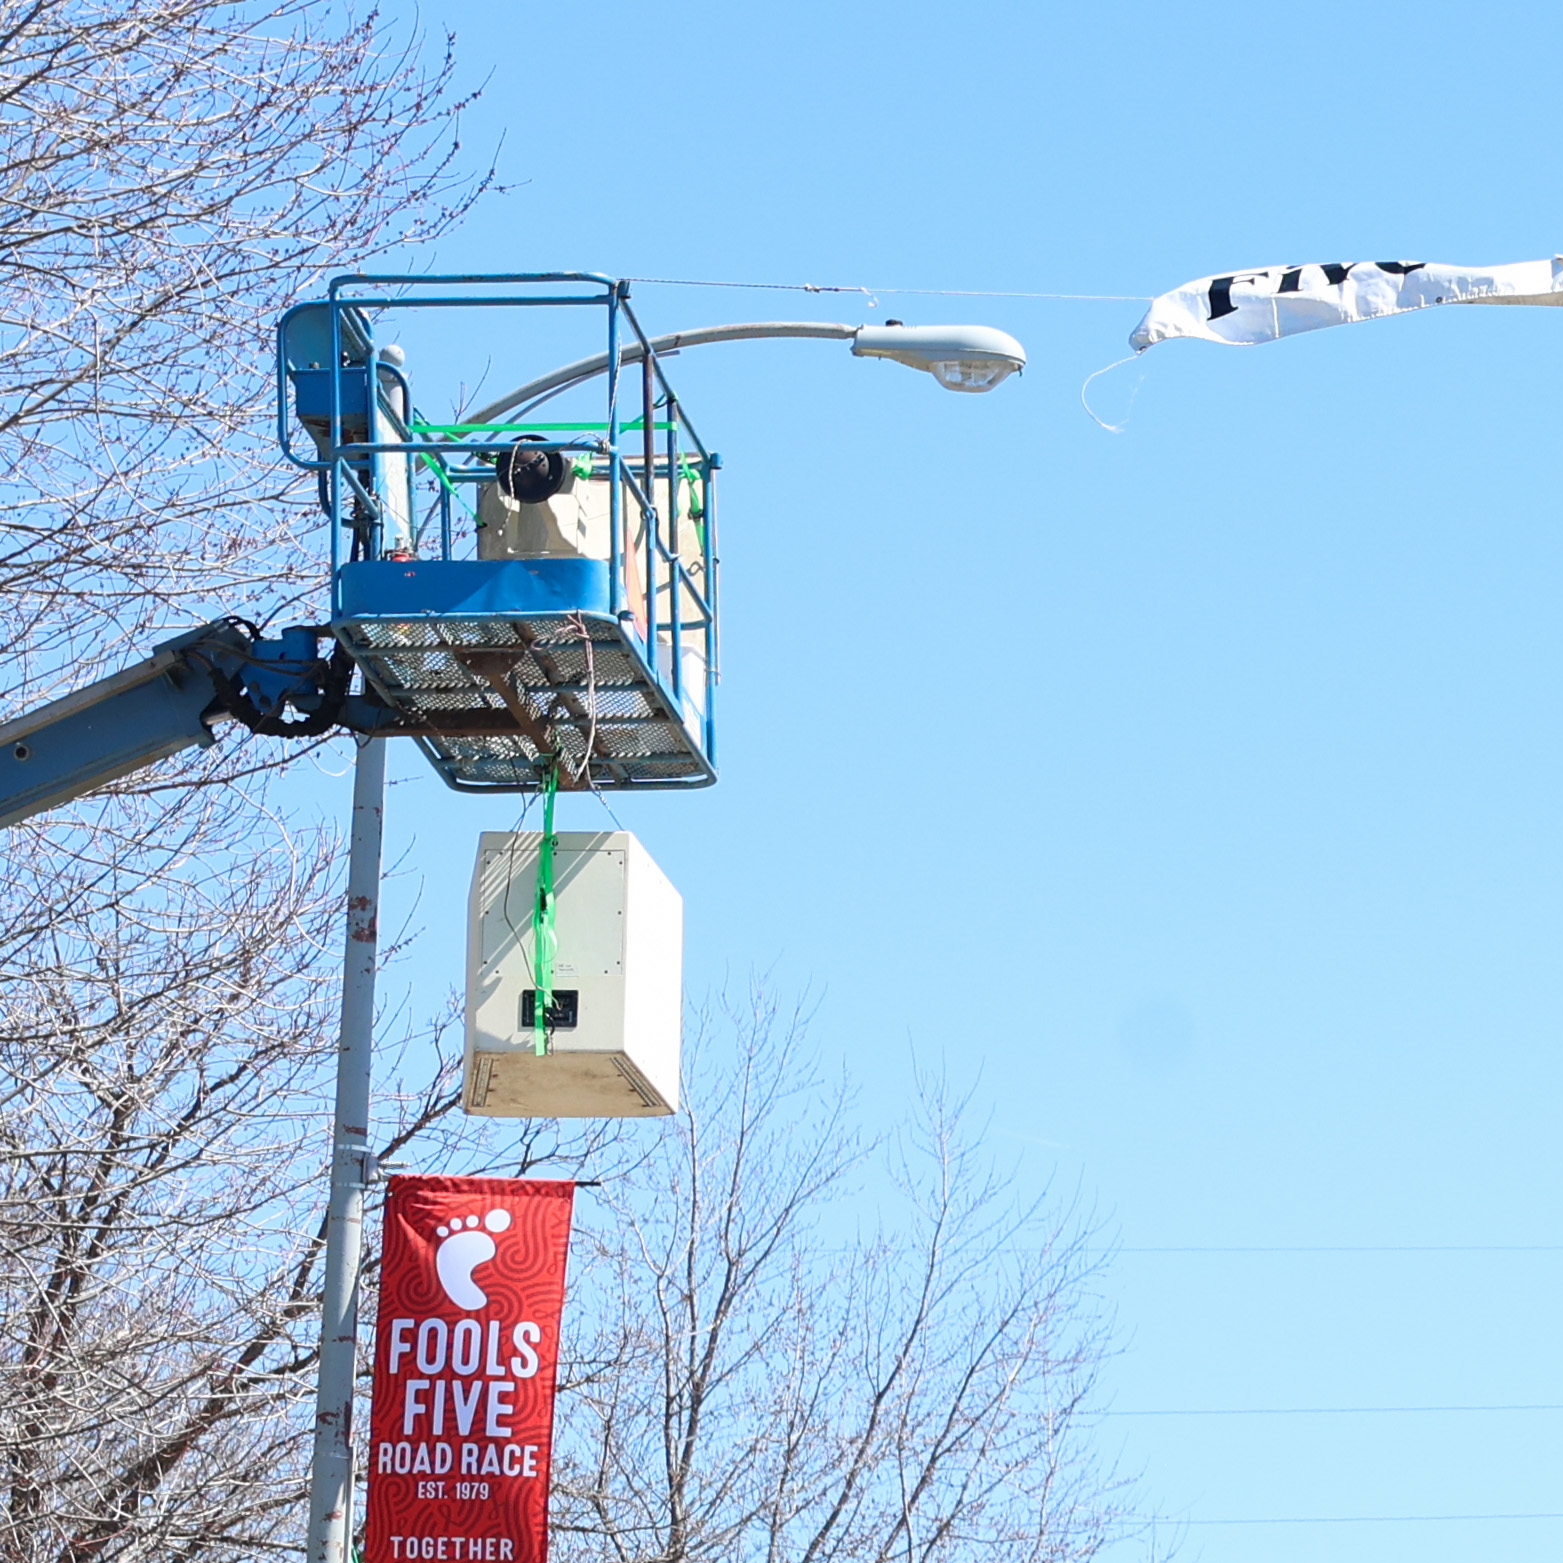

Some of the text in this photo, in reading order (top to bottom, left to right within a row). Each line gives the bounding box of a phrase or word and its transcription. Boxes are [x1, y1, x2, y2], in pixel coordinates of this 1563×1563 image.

[389, 1319, 541, 1378] FOOLS
[403, 1380, 516, 1438] FIVE
[378, 1442, 538, 1477] ROAD RACE
[417, 1481, 490, 1500] EST. 1979
[390, 1536, 514, 1562] TOGETHER
